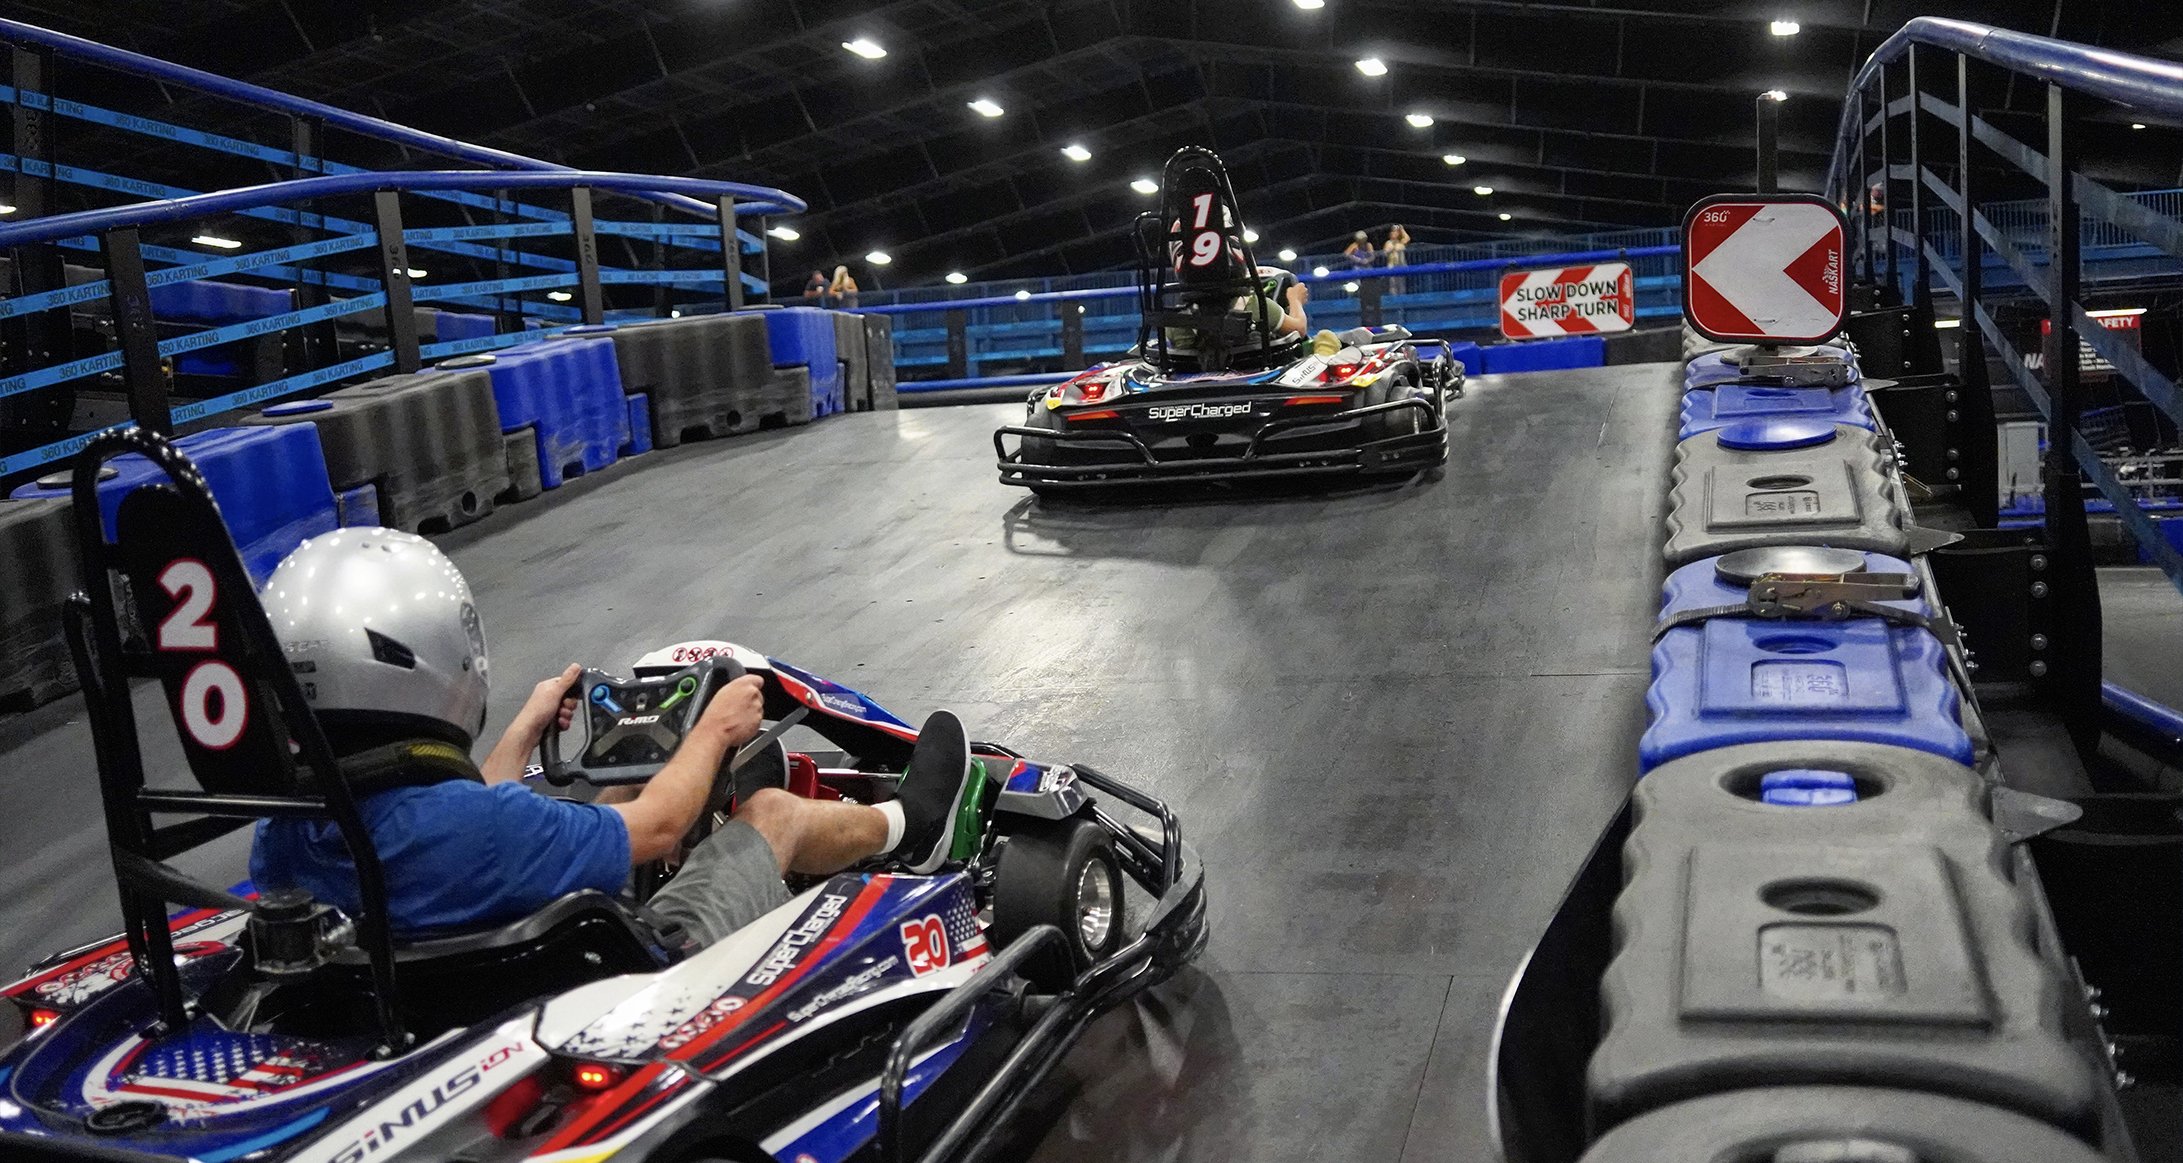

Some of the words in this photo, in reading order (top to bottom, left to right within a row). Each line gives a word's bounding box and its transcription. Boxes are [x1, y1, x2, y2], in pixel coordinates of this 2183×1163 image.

[133, 118, 177, 137] KARTING
[220, 138, 259, 156] KARTING
[121, 178, 165, 197] KARTING
[1704, 211, 1728, 223] 360
[141, 245, 176, 260] ARTING
[329, 237, 365, 253] KARTING
[251, 251, 291, 269] KARTING
[164, 264, 209, 282] KARTING
[1828, 248, 1839, 295] NASKART
[68, 282, 110, 301] KARTIN
[1516, 285, 1562, 302] SLOW
[1566, 280, 1617, 297] DOWN
[338, 299, 375, 315] KARTING
[1518, 304, 1570, 322] SHARP
[1575, 300, 1618, 317] TURN
[261, 315, 301, 332] KARTING
[175, 332, 219, 350] KARTING
[58, 365, 77, 380] 360
[328, 361, 364, 379] KARTING
[249, 382, 289, 401] KARTING
[1148, 401, 1252, 422] SuperCharged
[41, 445, 61, 462] 360
[745, 893, 849, 986] SuperCharged
[901, 914, 950, 978] 20
